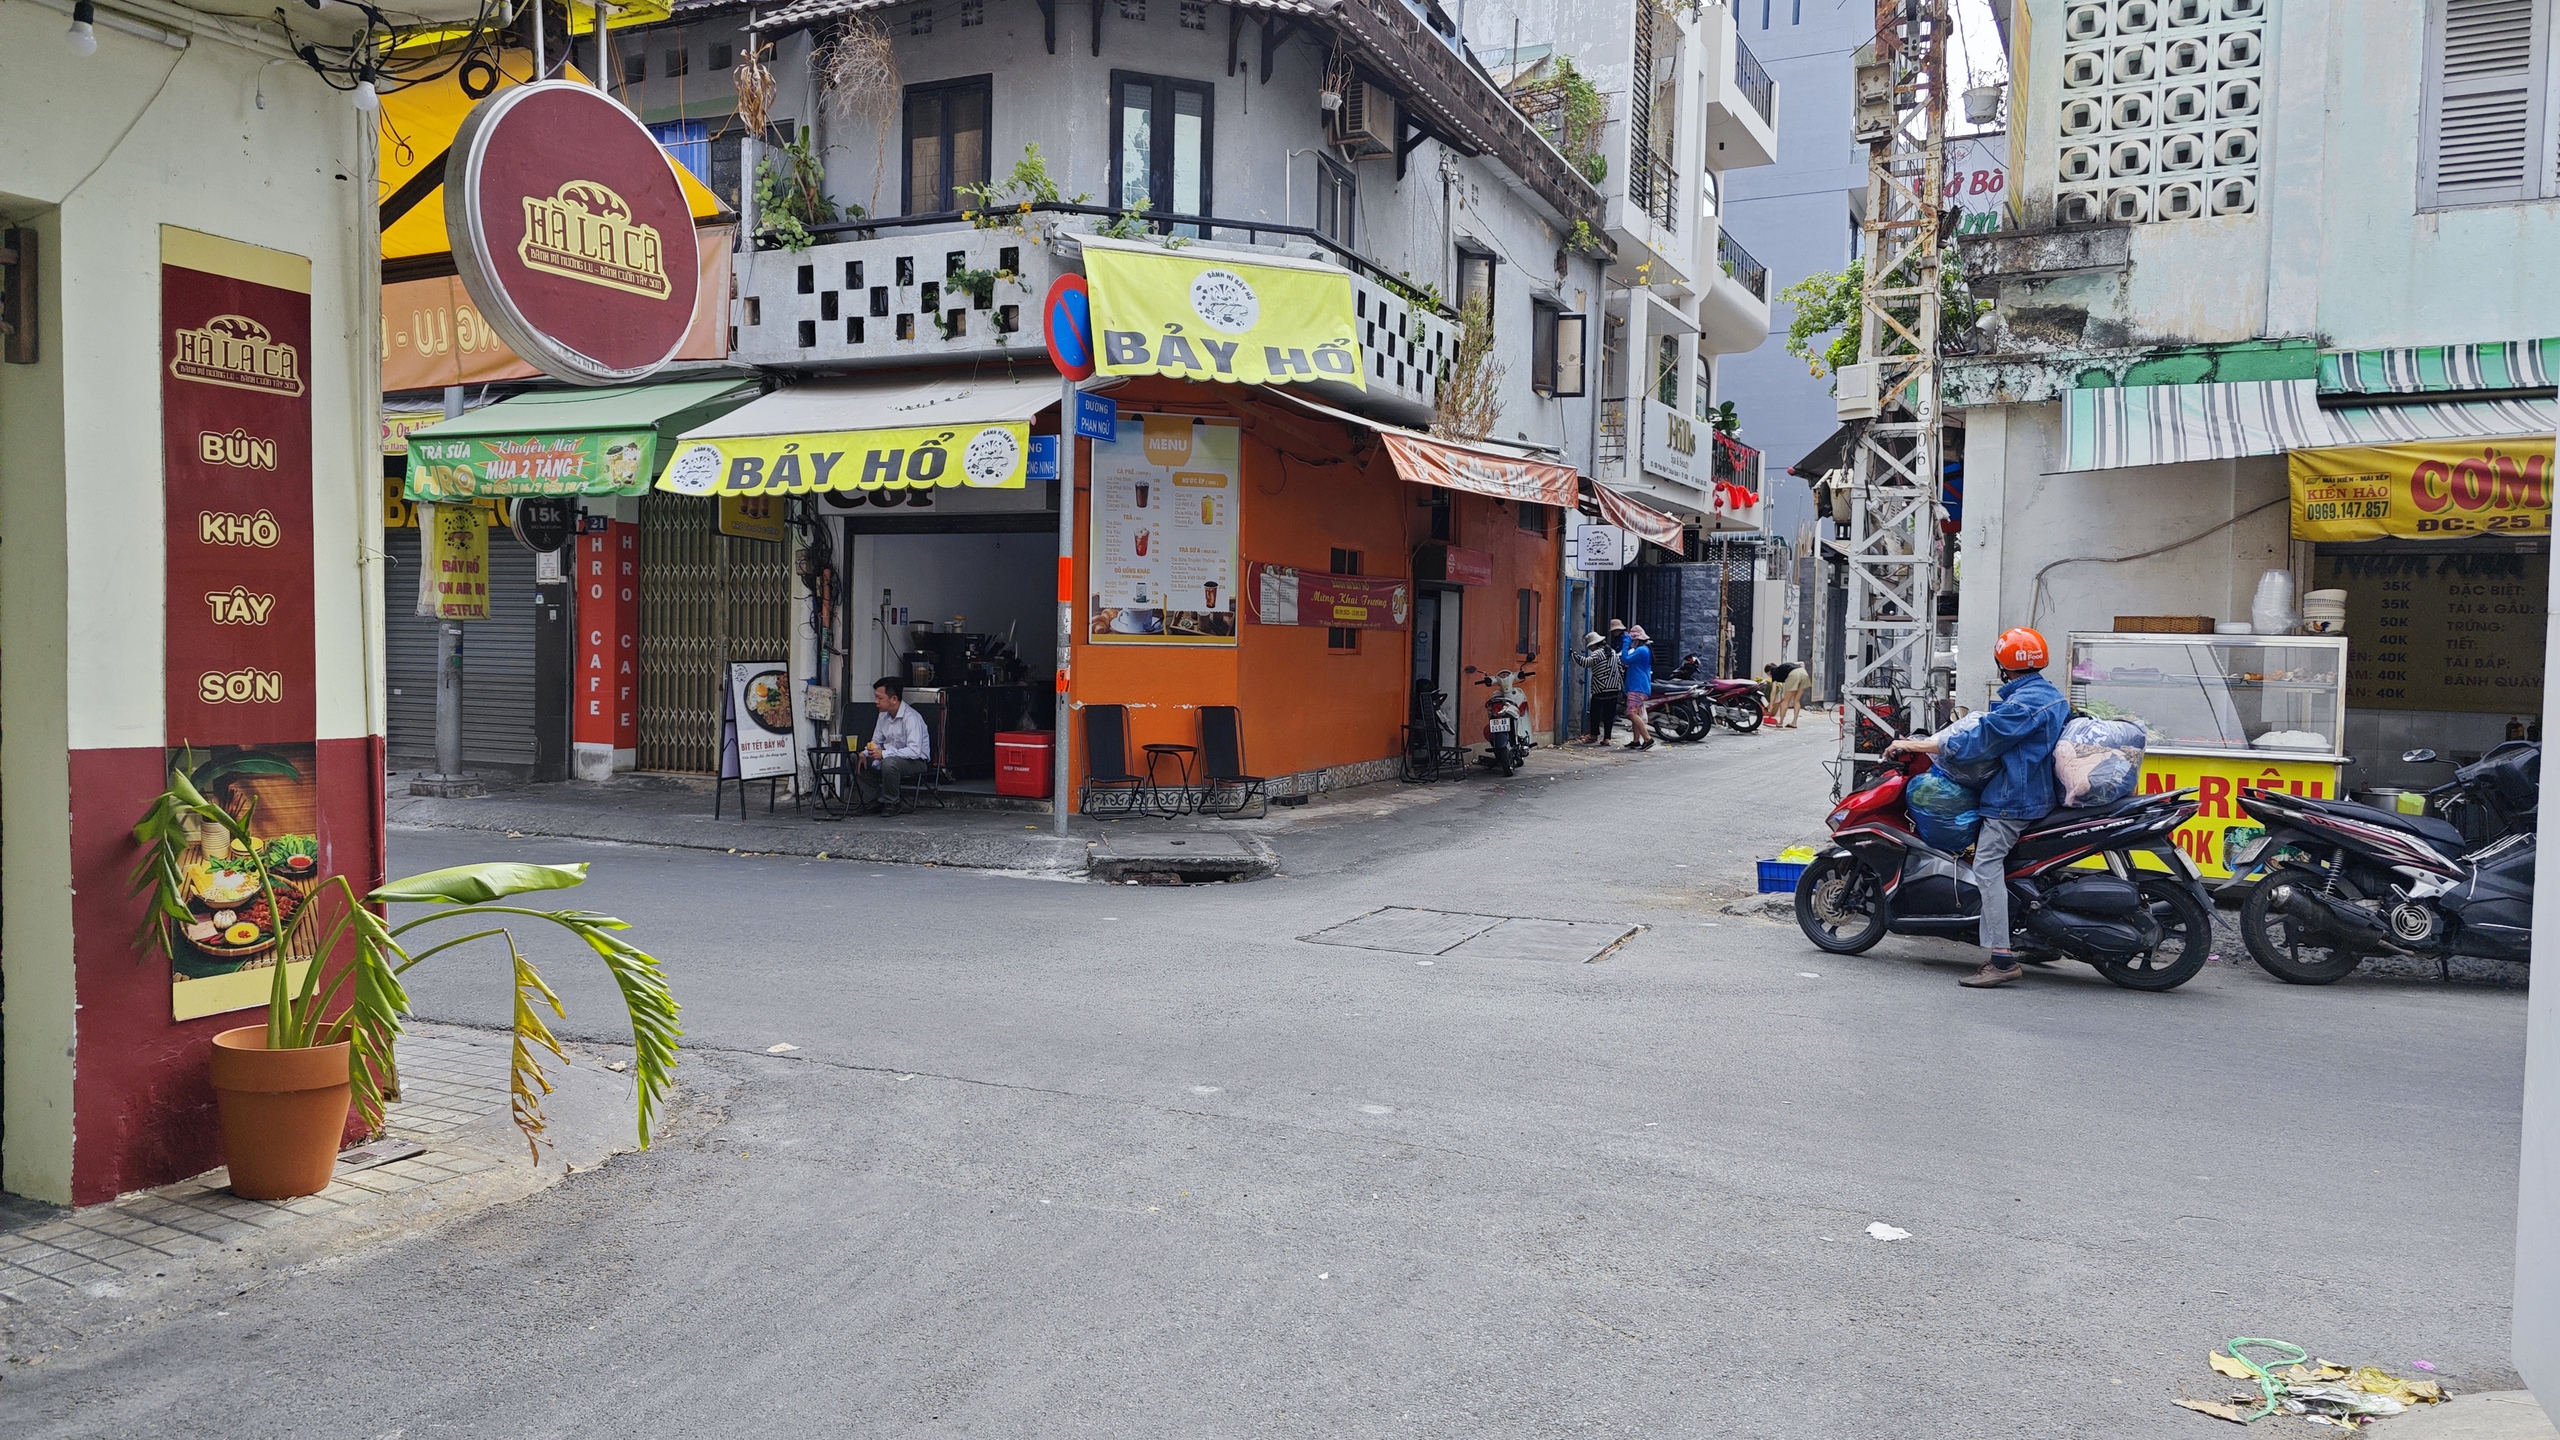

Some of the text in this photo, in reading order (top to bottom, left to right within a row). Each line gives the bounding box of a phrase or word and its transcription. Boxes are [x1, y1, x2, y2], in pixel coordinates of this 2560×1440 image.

[1969, 168, 2004, 196] Bò
[528, 203, 660, 275] HÀ LA CÀ
[180, 332, 295, 379] HÀ LA CÀ
[1104, 322, 1355, 376] BẢY HỔ
[1085, 399, 1109, 415] ĐƯỜNG
[1081, 417, 1097, 433] PHAN
[201, 429, 276, 470] BÚN
[419, 441, 471, 460] TRÀ SỮA
[1028, 442, 1043, 453] NG
[1149, 438, 1188, 452] MENU
[726, 431, 955, 489] BẢY HỔ
[485, 460, 516, 480] MUA
[521, 461, 530, 478] 2
[576, 461, 583, 477] 1
[413, 463, 476, 496] HRO
[2411, 447, 2546, 513] CƠM
[2306, 484, 2389, 501] KIẾN HÀO
[528, 507, 562, 522] 15k
[2307, 500, 2389, 521] 0969.147.857
[201, 510, 279, 547] KHÔ
[590, 521, 604, 529] 21
[2417, 517, 2475, 532] ĐC:
[2486, 515, 2531, 530] 25
[442, 555, 481, 574] BẢY HỔ
[438, 581, 486, 596] ON AIR IN
[2382, 581, 2411, 592] 35K
[206, 586, 275, 625] TÂY
[1338, 593, 1358, 605] Khai
[2381, 599, 2410, 609] 35K
[443, 603, 484, 617] NETFLIX
[590, 537, 603, 716] HRO CAFE
[2380, 617, 2409, 627] 50K
[620, 535, 633, 727] HRO CAFE
[2378, 635, 2408, 646] 40K
[2028, 653, 2043, 661] Food
[2377, 653, 2407, 663] 40K
[2377, 670, 2407, 681] 40K
[200, 668, 281, 703] SƠN
[2376, 688, 2406, 699] 40K
[2170, 828, 2214, 864] 0K
